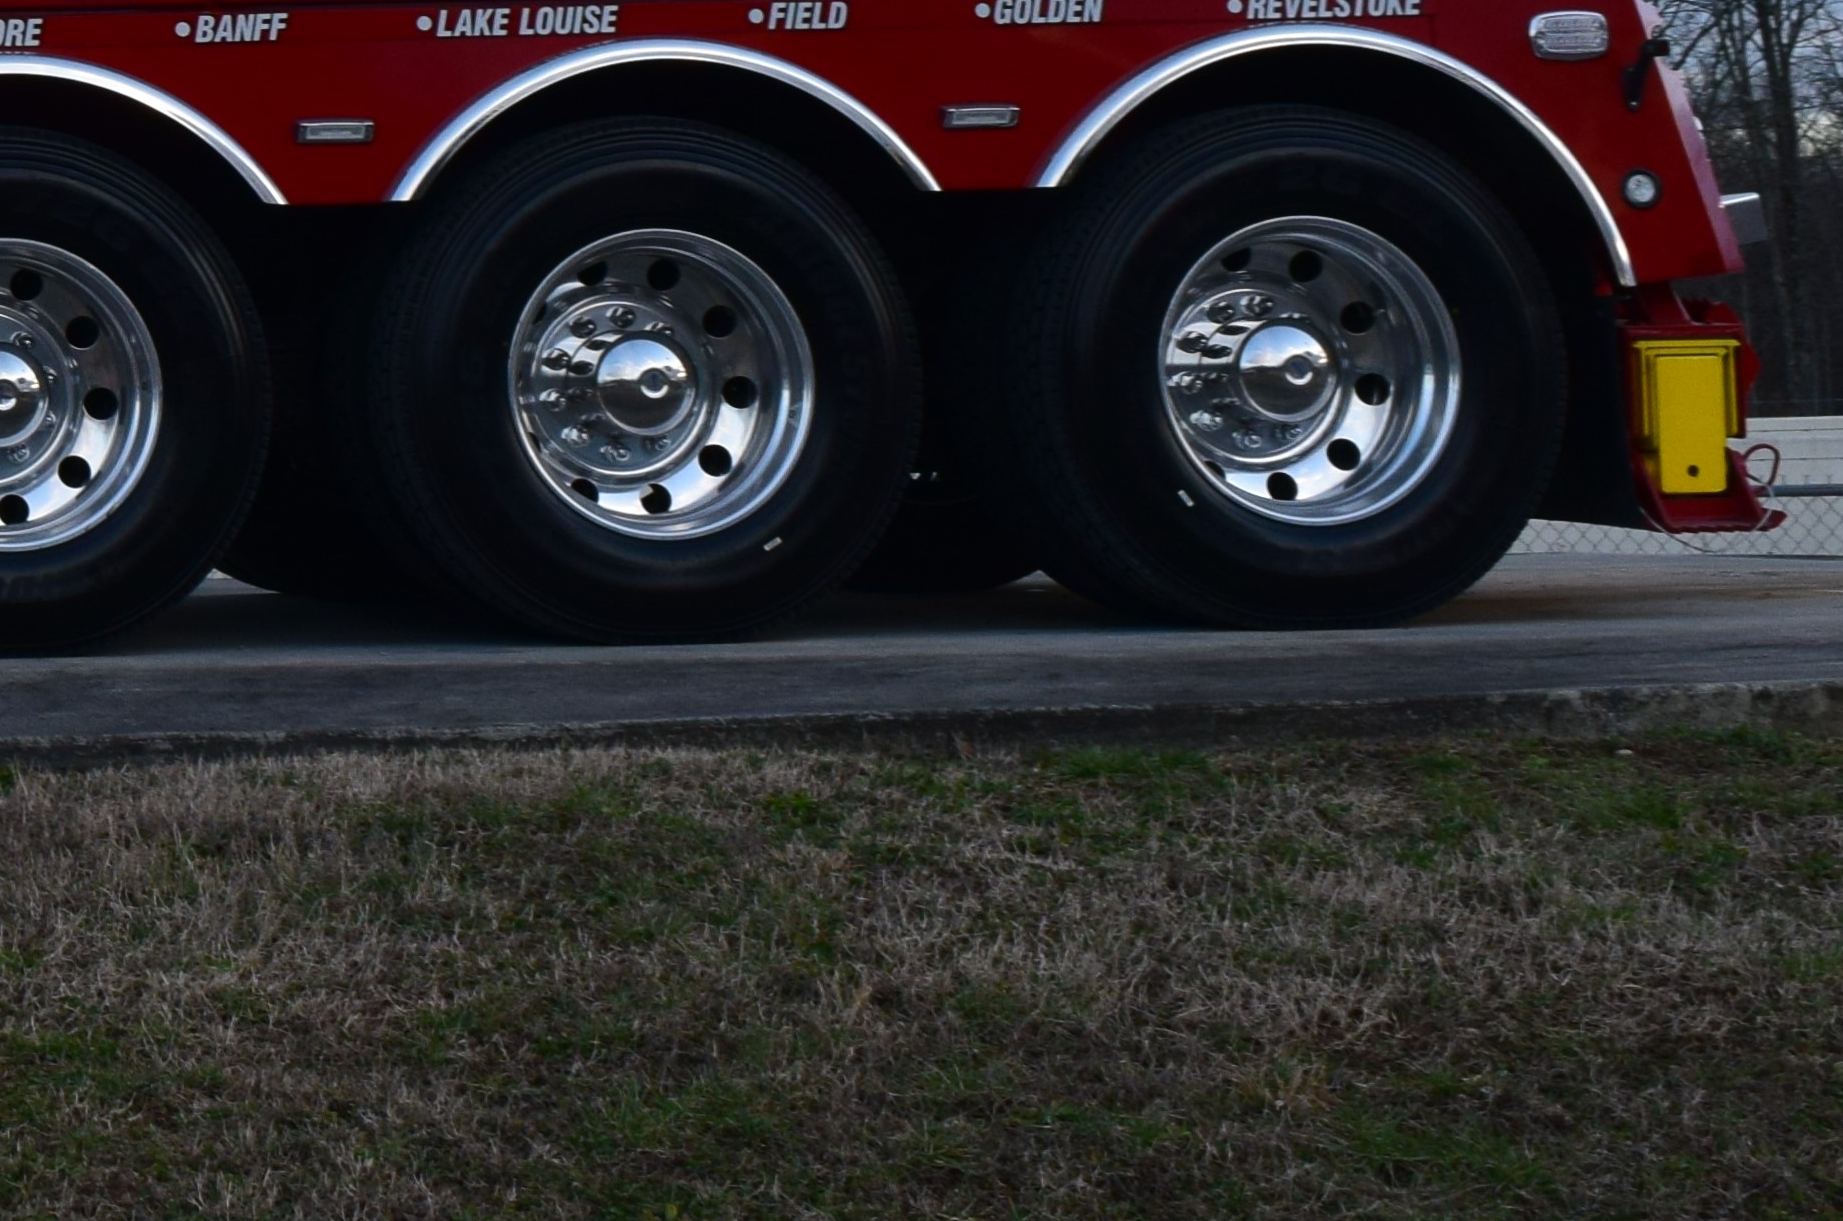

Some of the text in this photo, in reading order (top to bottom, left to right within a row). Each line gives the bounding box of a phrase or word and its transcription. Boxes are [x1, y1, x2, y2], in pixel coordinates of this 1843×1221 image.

[195, 12, 288, 43] BANFF
[436, 4, 619, 37] LAKE LOUISE
[768, 1, 848, 30] FIELD
